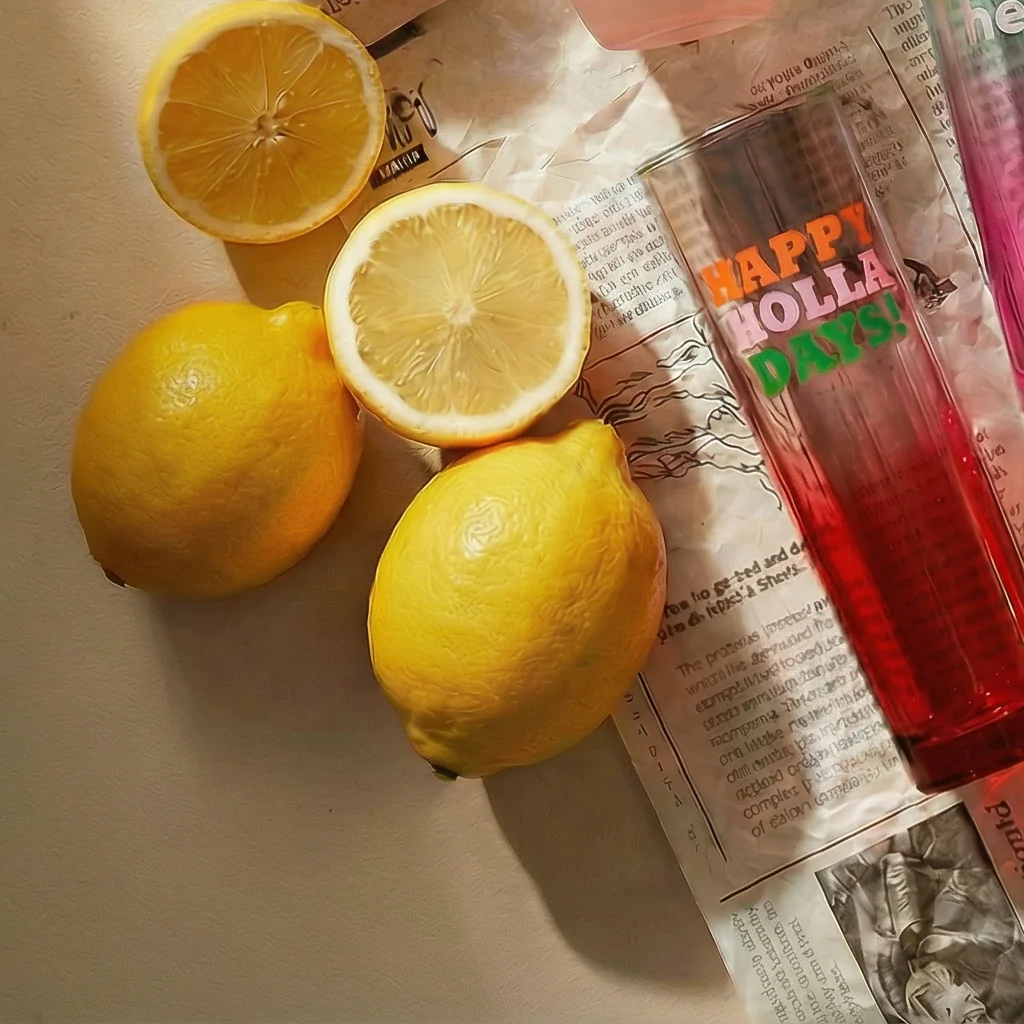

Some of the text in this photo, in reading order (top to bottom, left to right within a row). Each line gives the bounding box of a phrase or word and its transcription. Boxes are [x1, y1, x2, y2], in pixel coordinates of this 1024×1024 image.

[701, 201, 873, 309] HAPPY
[724, 248, 897, 352] HOLLA
[747, 291, 908, 399] DAYS!
